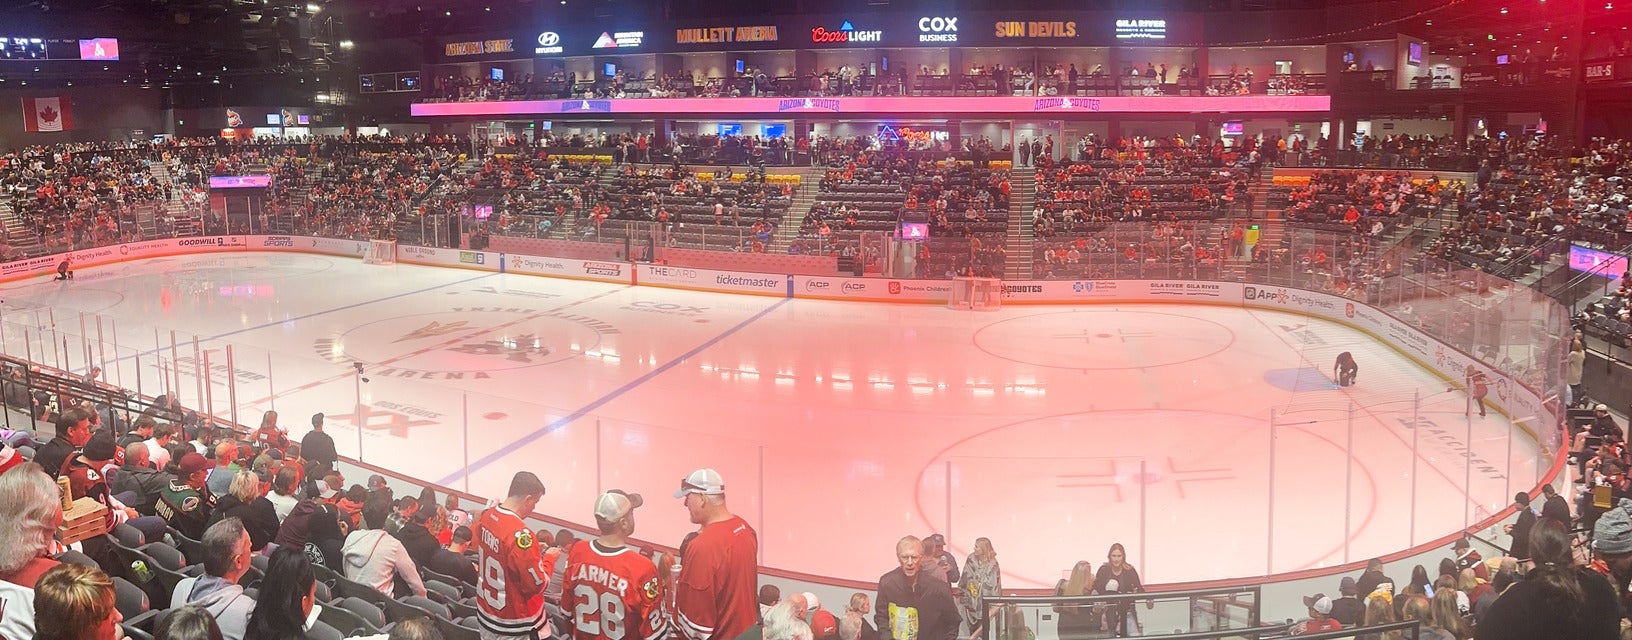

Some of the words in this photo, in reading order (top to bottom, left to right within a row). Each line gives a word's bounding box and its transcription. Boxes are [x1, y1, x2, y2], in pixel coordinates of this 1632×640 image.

[918, 17, 958, 32] COX
[995, 21, 1025, 38] SUN
[1028, 21, 1076, 38] DEVILS
[676, 27, 734, 44] MULLETT
[735, 26, 777, 42] ARENA
[812, 26, 848, 43] Coors
[848, 30, 882, 42] LIGHT
[1586, 64, 1612, 78] BAR-S
[779, 98, 806, 112] ARIZONA
[811, 98, 840, 112] COYOTES
[1034, 98, 1064, 111] ARIZONA
[1070, 98, 1100, 112] COYOTES
[76, 252, 95, 261] Dignity
[96, 250, 112, 258] Health
[525, 259, 544, 269] Dignity
[546, 260, 564, 270] Health
[716, 274, 778, 288] ticketmaster
[376, 368, 492, 380] ARENA
[1428, 430, 1508, 480] ACCIDENT
[476, 544, 506, 610] 19
[574, 584, 626, 640] 28
